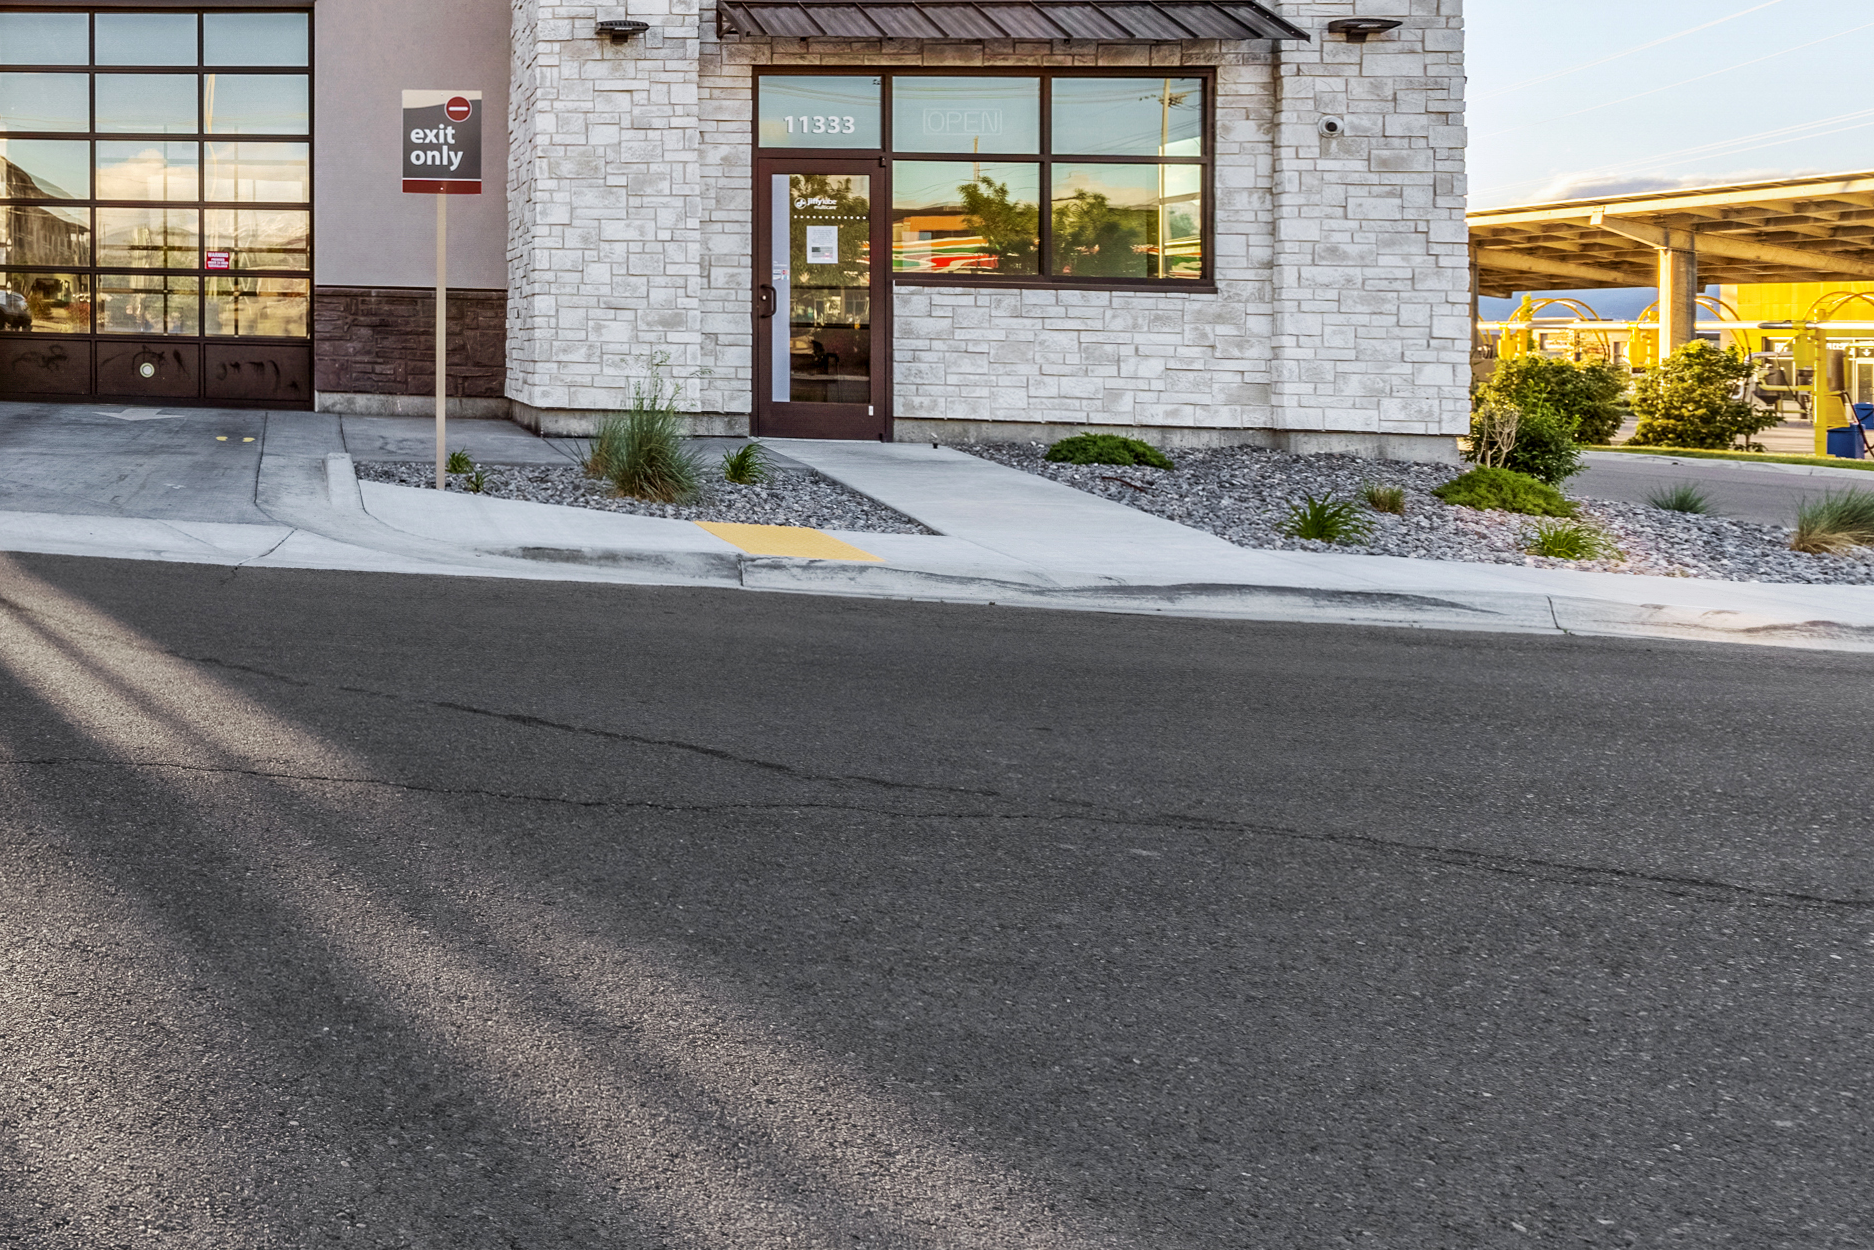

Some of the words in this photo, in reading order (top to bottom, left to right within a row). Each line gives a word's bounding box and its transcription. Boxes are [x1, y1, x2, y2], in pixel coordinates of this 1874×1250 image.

[784, 115, 856, 134] 11333
[927, 110, 999, 133] OPEN
[410, 123, 456, 144] exit
[410, 145, 464, 171] only
